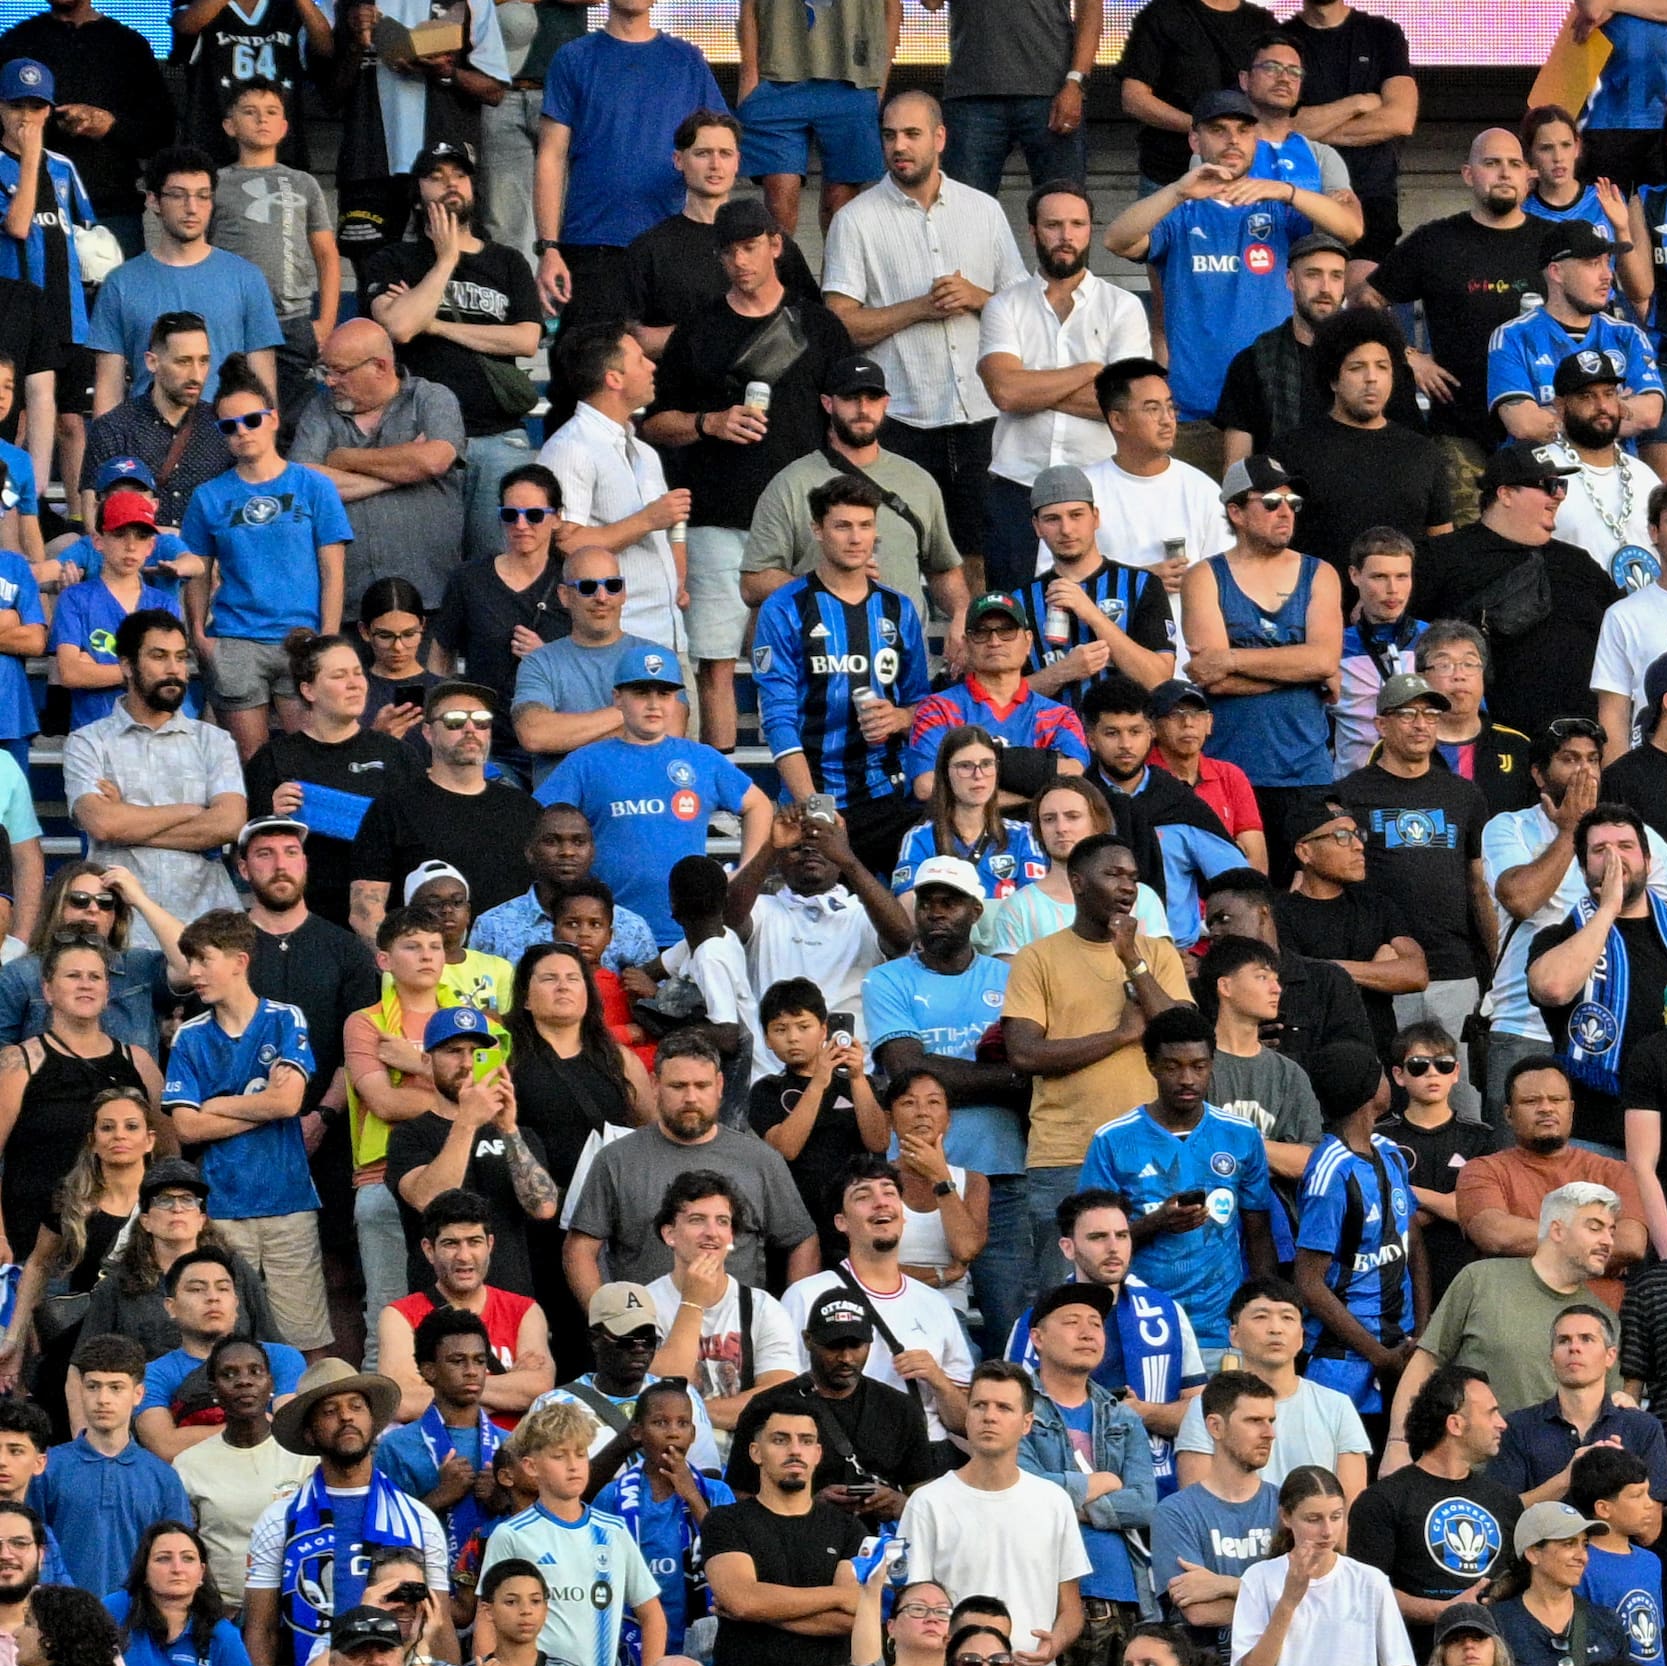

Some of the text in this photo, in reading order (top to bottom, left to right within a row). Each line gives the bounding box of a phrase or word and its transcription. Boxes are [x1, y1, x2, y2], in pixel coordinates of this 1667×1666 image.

[216, 31, 292, 48] LONDON
[232, 44, 276, 81] 64
[33, 212, 58, 227] MO
[811, 655, 868, 674] BMO
[610, 799, 665, 817] BMO
[626, 1291, 644, 1309] A
[820, 1300, 865, 1317] OTTAWA
[650, 1558, 677, 1575] MO
[546, 1586, 584, 1602] MO
